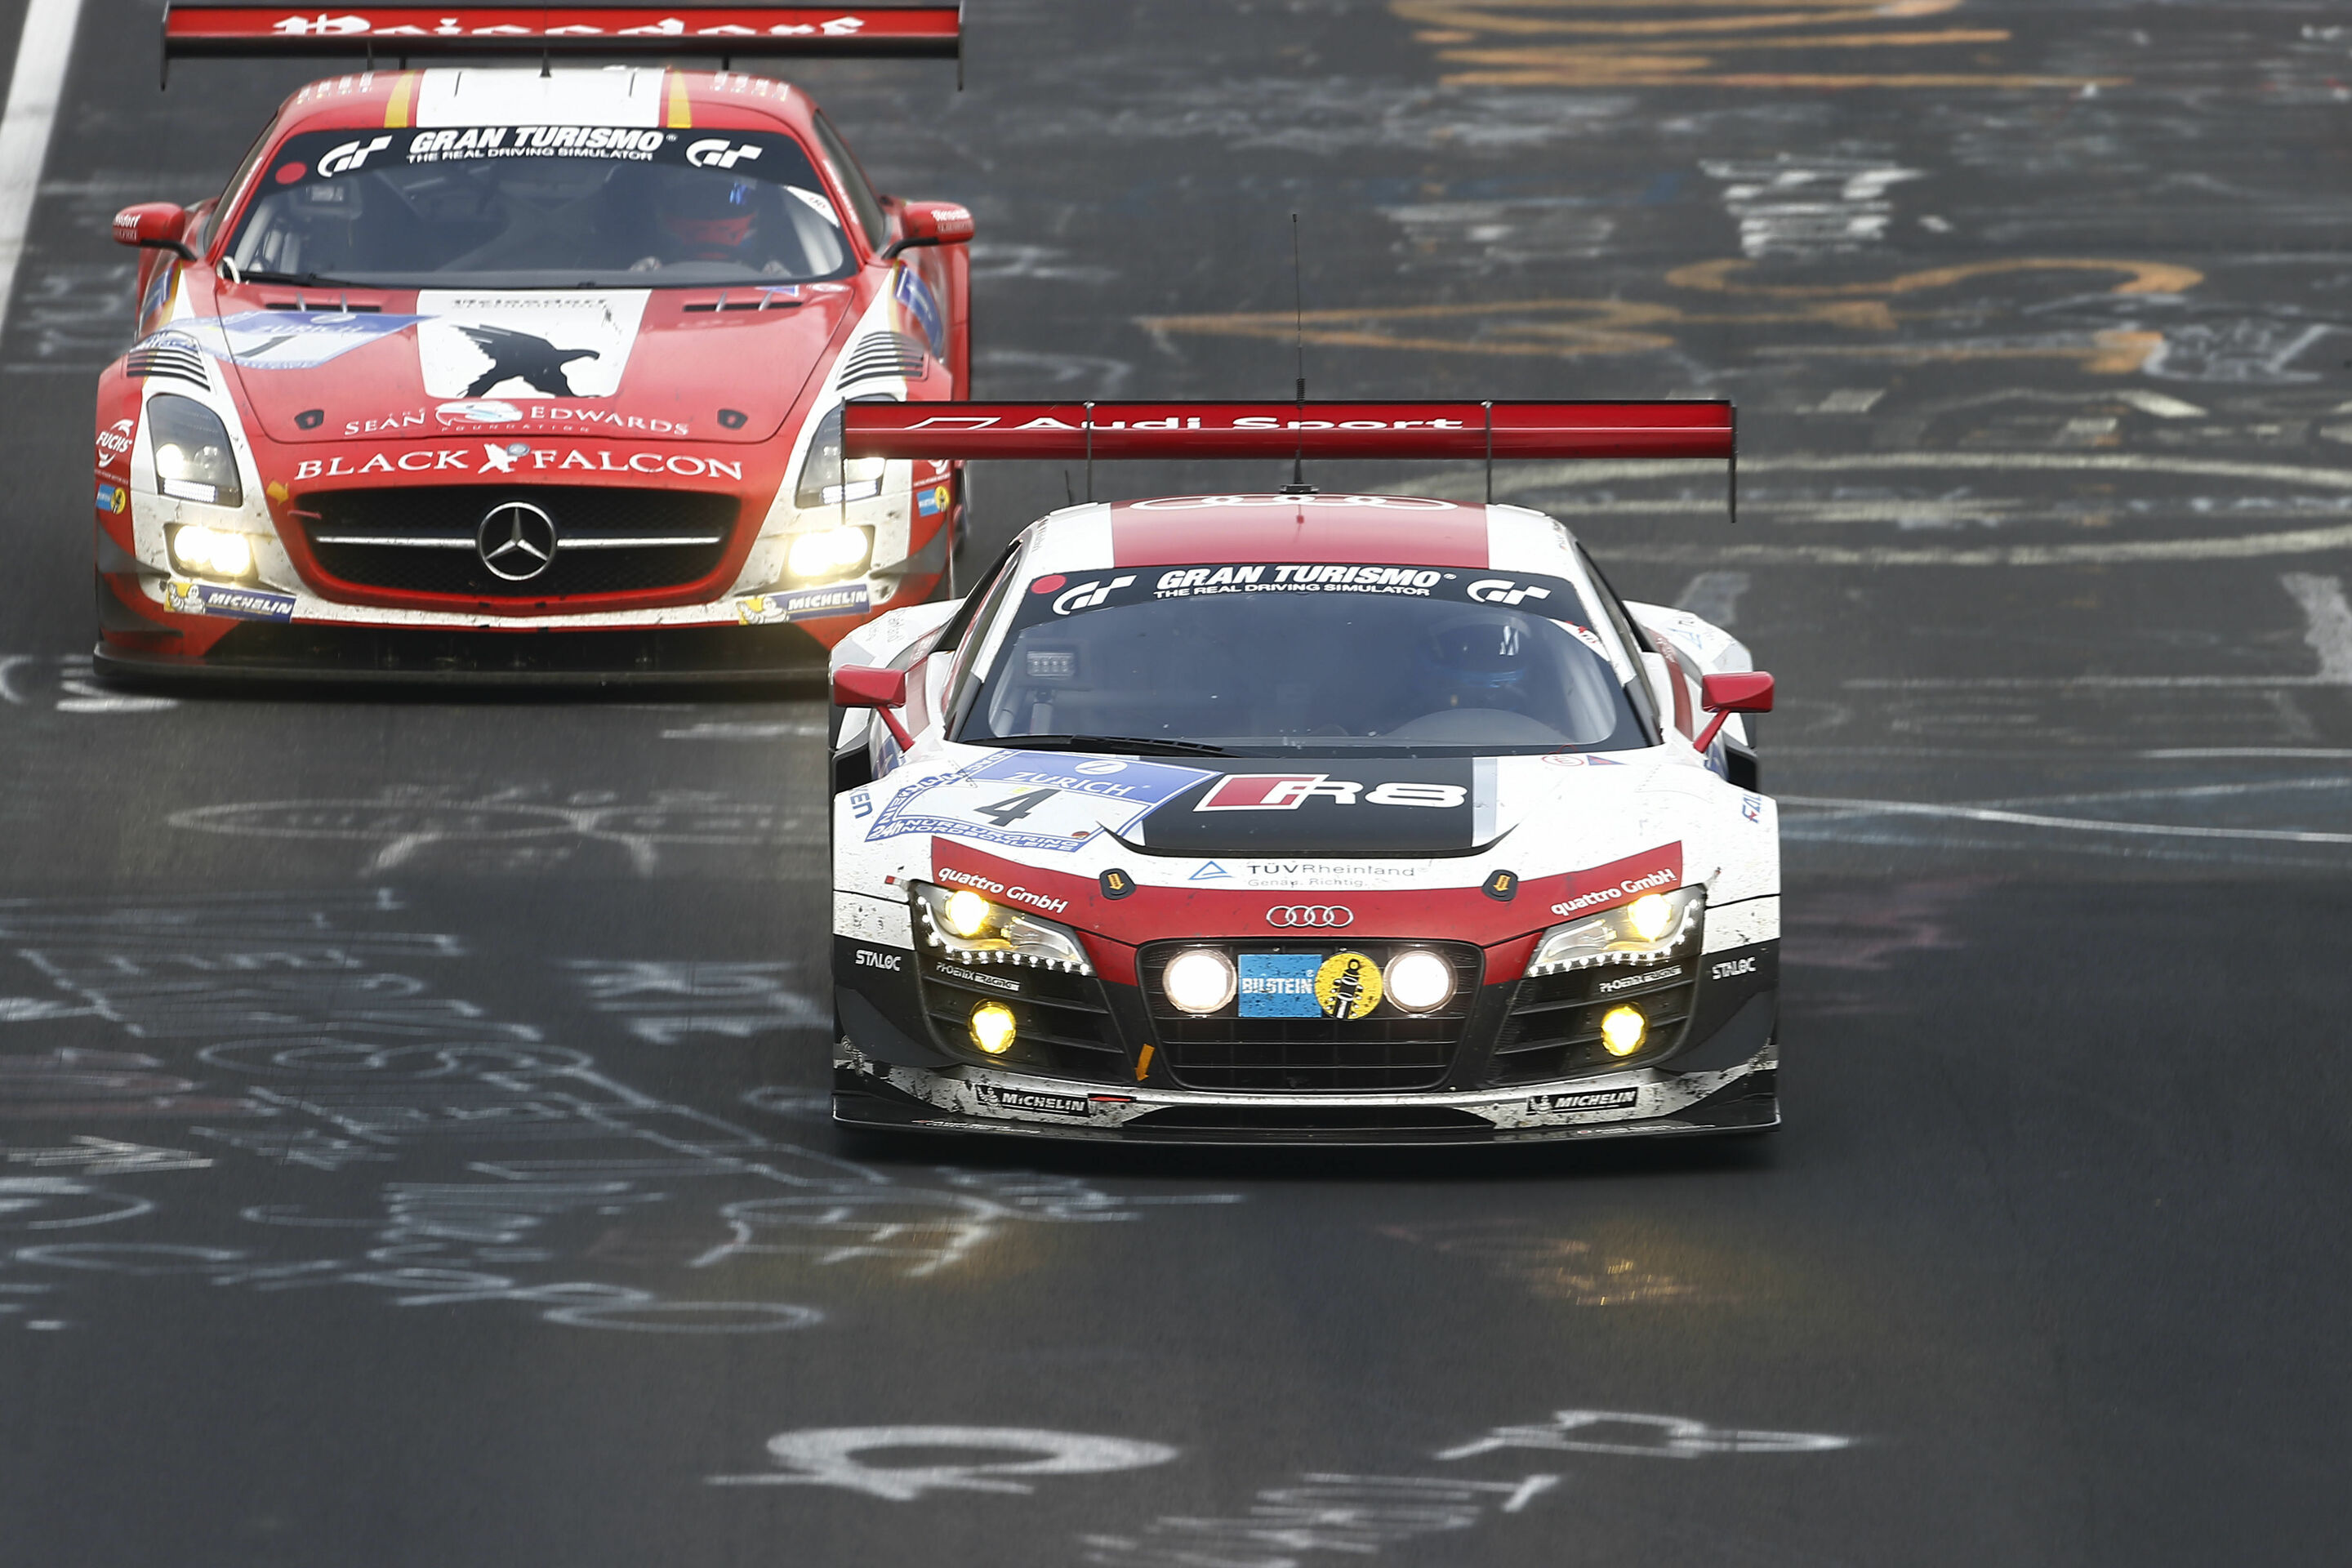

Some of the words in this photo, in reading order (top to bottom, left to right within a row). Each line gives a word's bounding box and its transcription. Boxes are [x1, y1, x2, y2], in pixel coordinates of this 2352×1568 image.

[409, 127, 507, 155] GRAN
[514, 127, 664, 152] TURISMO
[407, 153, 439, 164] THE
[442, 149, 485, 160] REAL
[488, 147, 554, 158] DRIVING
[558, 148, 653, 162] SIMULATOR
[344, 408, 425, 436] SEAN
[530, 406, 689, 436] EDWARDS
[1013, 416, 1201, 430] Audi
[1232, 417, 1463, 430] Sport
[96, 431, 131, 452] FUCHS
[295, 450, 469, 480] BLACK
[532, 450, 743, 480] FALCON
[1156, 567, 1263, 590] GRAN
[1274, 565, 1441, 587] TURISMO
[787, 590, 868, 611] MICHELIN
[1153, 589, 1192, 599] THE
[1194, 584, 1241, 595] REAL
[1244, 583, 1321, 593] DRIVING
[1324, 583, 1431, 596] SIMULATOR
[207, 593, 293, 616] MICHELIN
[1003, 770, 1136, 797] ZURICH
[1258, 779, 1468, 808] R8
[974, 788, 1064, 827] 4
[938, 866, 1004, 895] quattro
[1005, 885, 1068, 914] GmbH
[1550, 883, 1622, 916] quattro
[1620, 867, 1677, 894] GmbH
[855, 949, 902, 972] STALOC
[1712, 957, 1757, 980] STALOC
[1242, 978, 1313, 995] BILSTEIN
[1001, 1093, 1085, 1112] MICHELIN
[1555, 1090, 1637, 1109] MICHELIN
